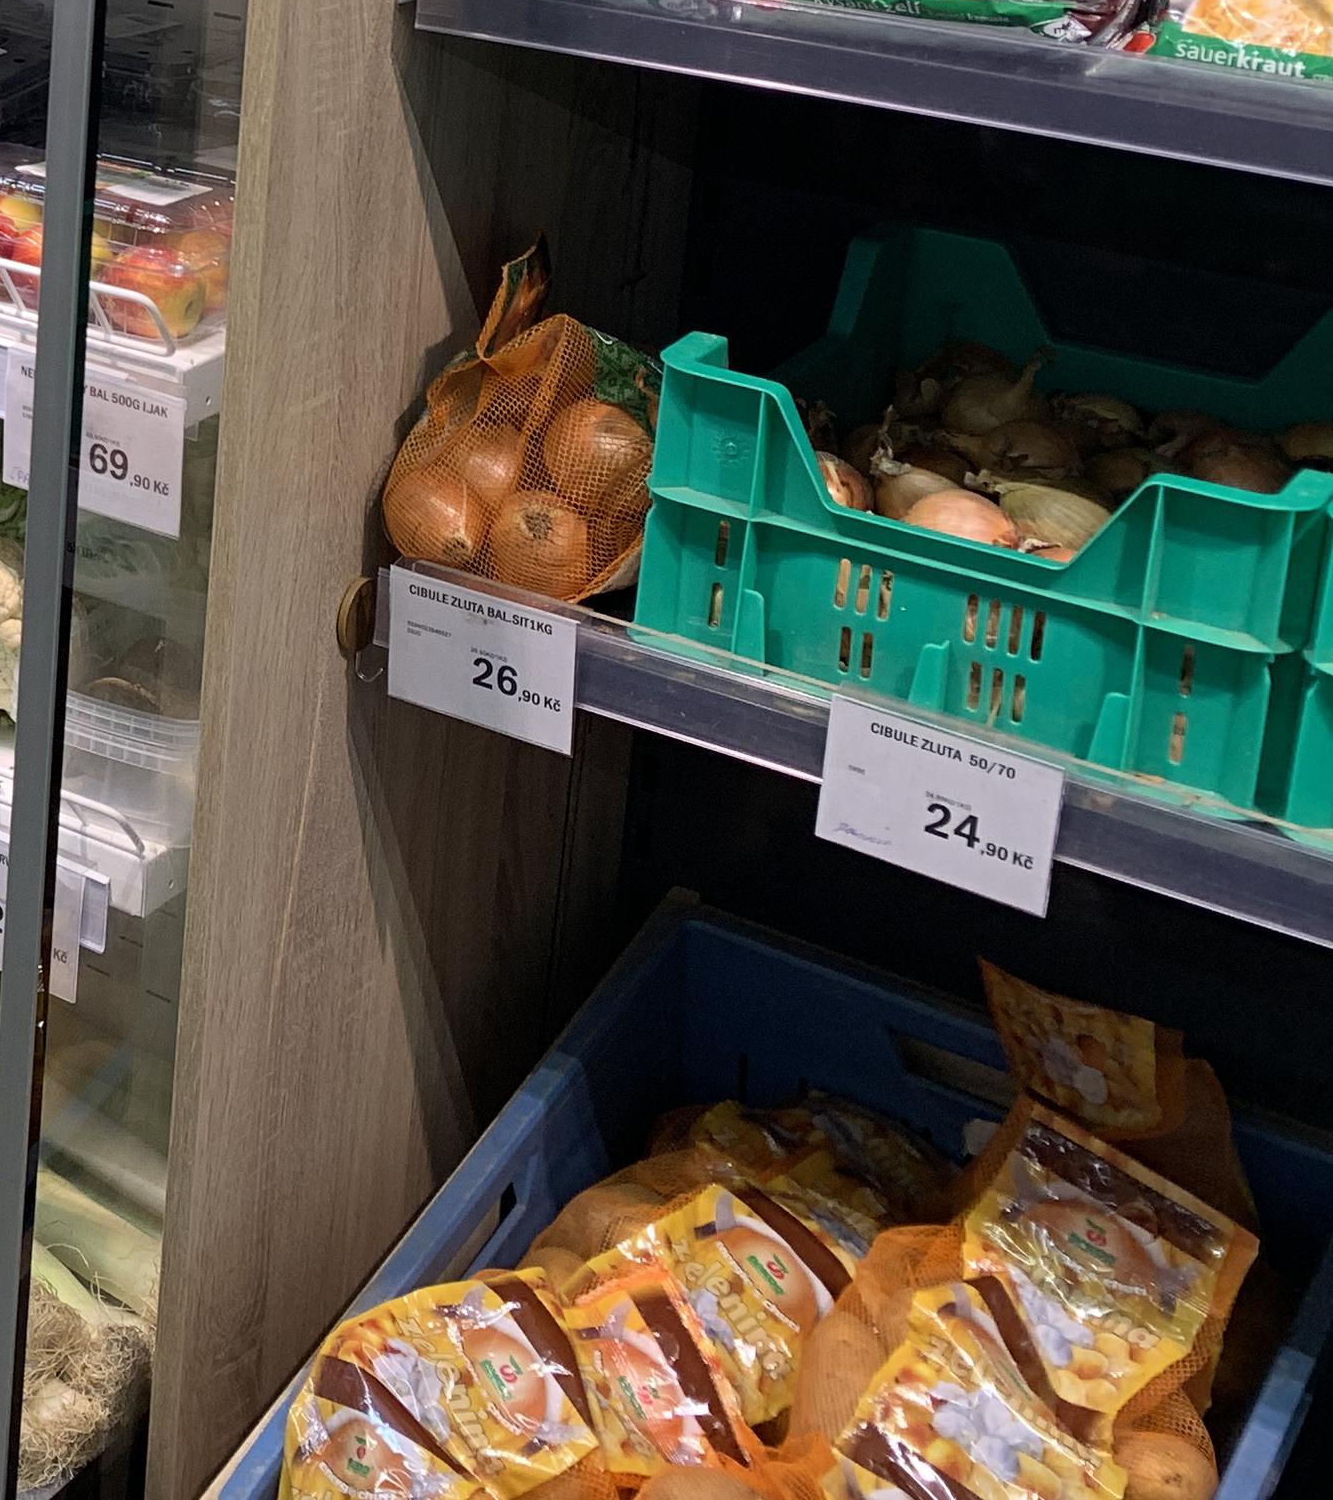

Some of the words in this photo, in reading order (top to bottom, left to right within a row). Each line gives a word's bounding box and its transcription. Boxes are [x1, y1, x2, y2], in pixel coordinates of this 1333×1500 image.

[1174, 40, 1306, 79] sauerkraut
[88, 385, 108, 400] BAL
[110, 391, 139, 410] 500G
[88, 442, 150, 491] 69,90
[152, 478, 169, 497] Kč
[408, 584, 449, 605] CIBULE
[450, 596, 484, 615] ZLUTA
[472, 657, 540, 706] 26,90
[544, 696, 561, 712] Kč
[870, 722, 919, 747] CIBULE
[920, 738, 962, 762] ZLUTA
[969, 754, 1016, 780] 50/70
[924, 802, 1008, 861] 24,90
[1012, 851, 1034, 870] Kč
[52, 947, 68, 965] Kč
